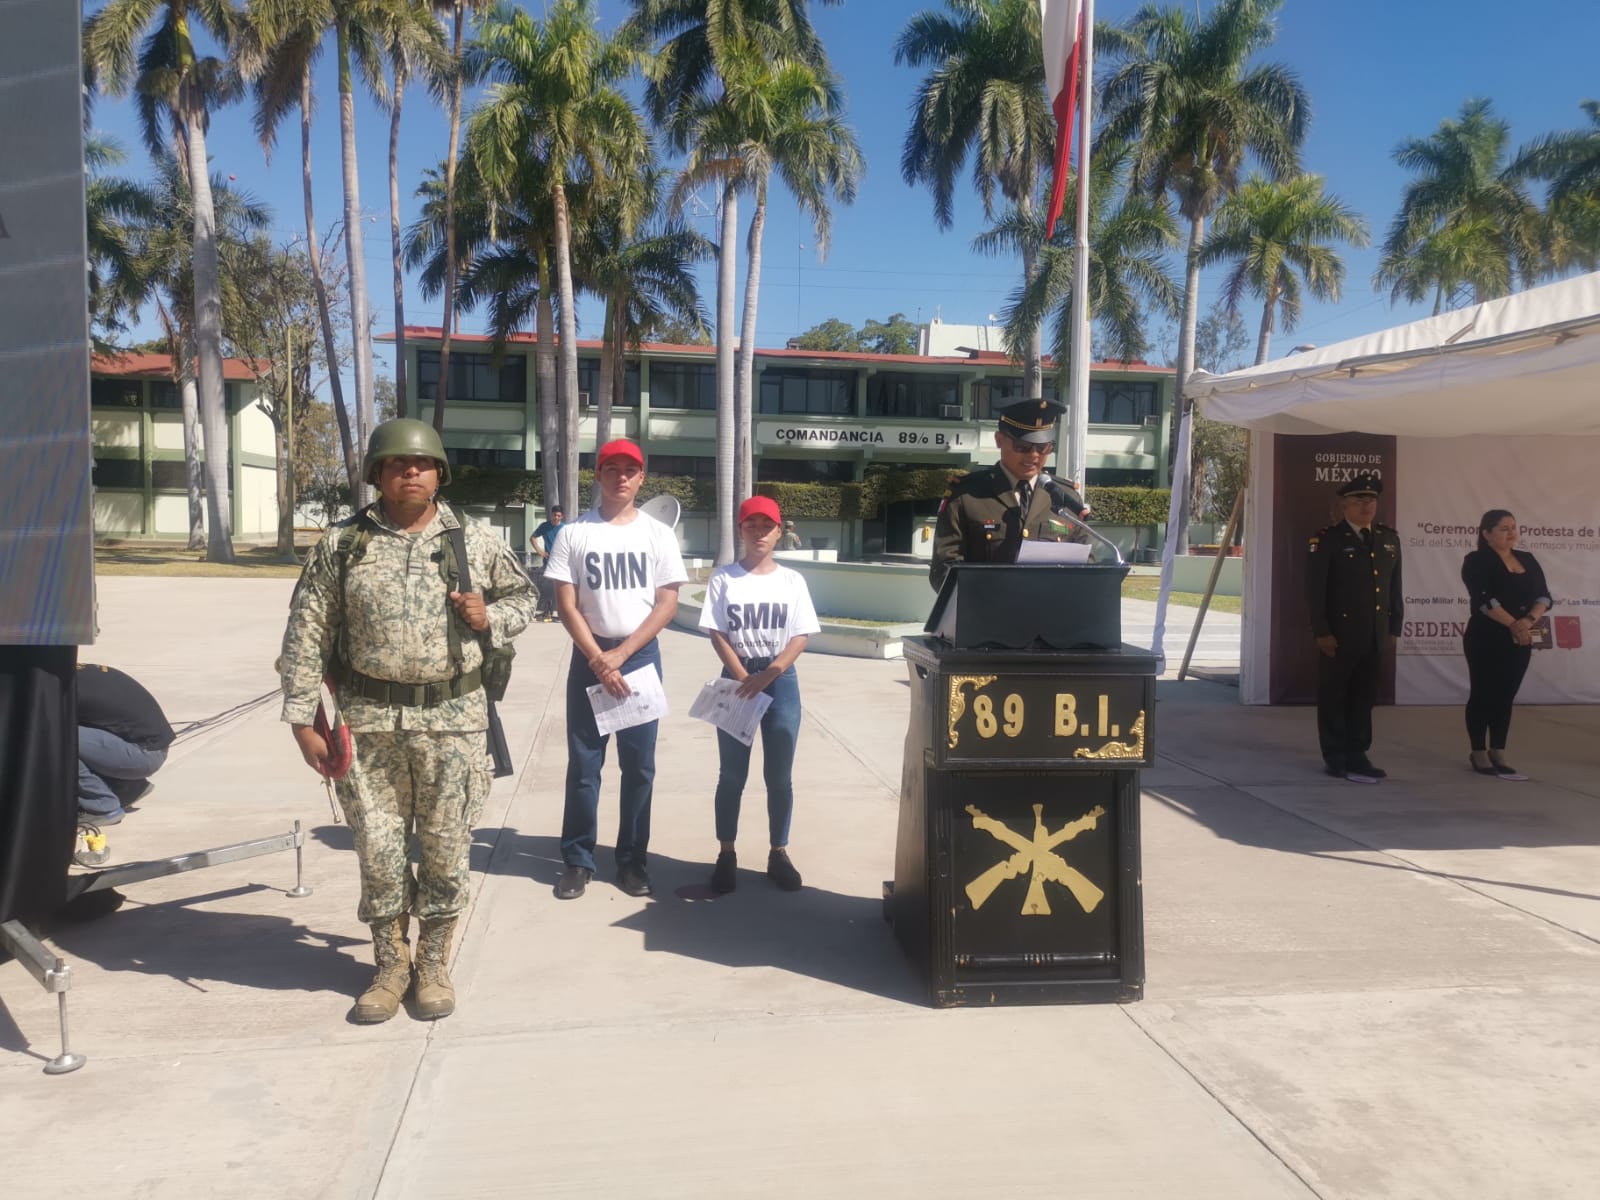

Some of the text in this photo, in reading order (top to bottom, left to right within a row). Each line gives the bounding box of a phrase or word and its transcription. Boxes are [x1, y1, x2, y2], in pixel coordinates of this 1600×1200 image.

[776, 429, 884, 443] COMANDANCIA
[1315, 453, 1382, 464] GOBIERNO DE
[1519, 525, 1574, 537] Protesta
[1578, 526, 1595, 537] de
[585, 552, 647, 590] SMN
[1405, 596, 1430, 605] Campo
[727, 602, 788, 631] SMN
[973, 693, 1024, 738] 89
